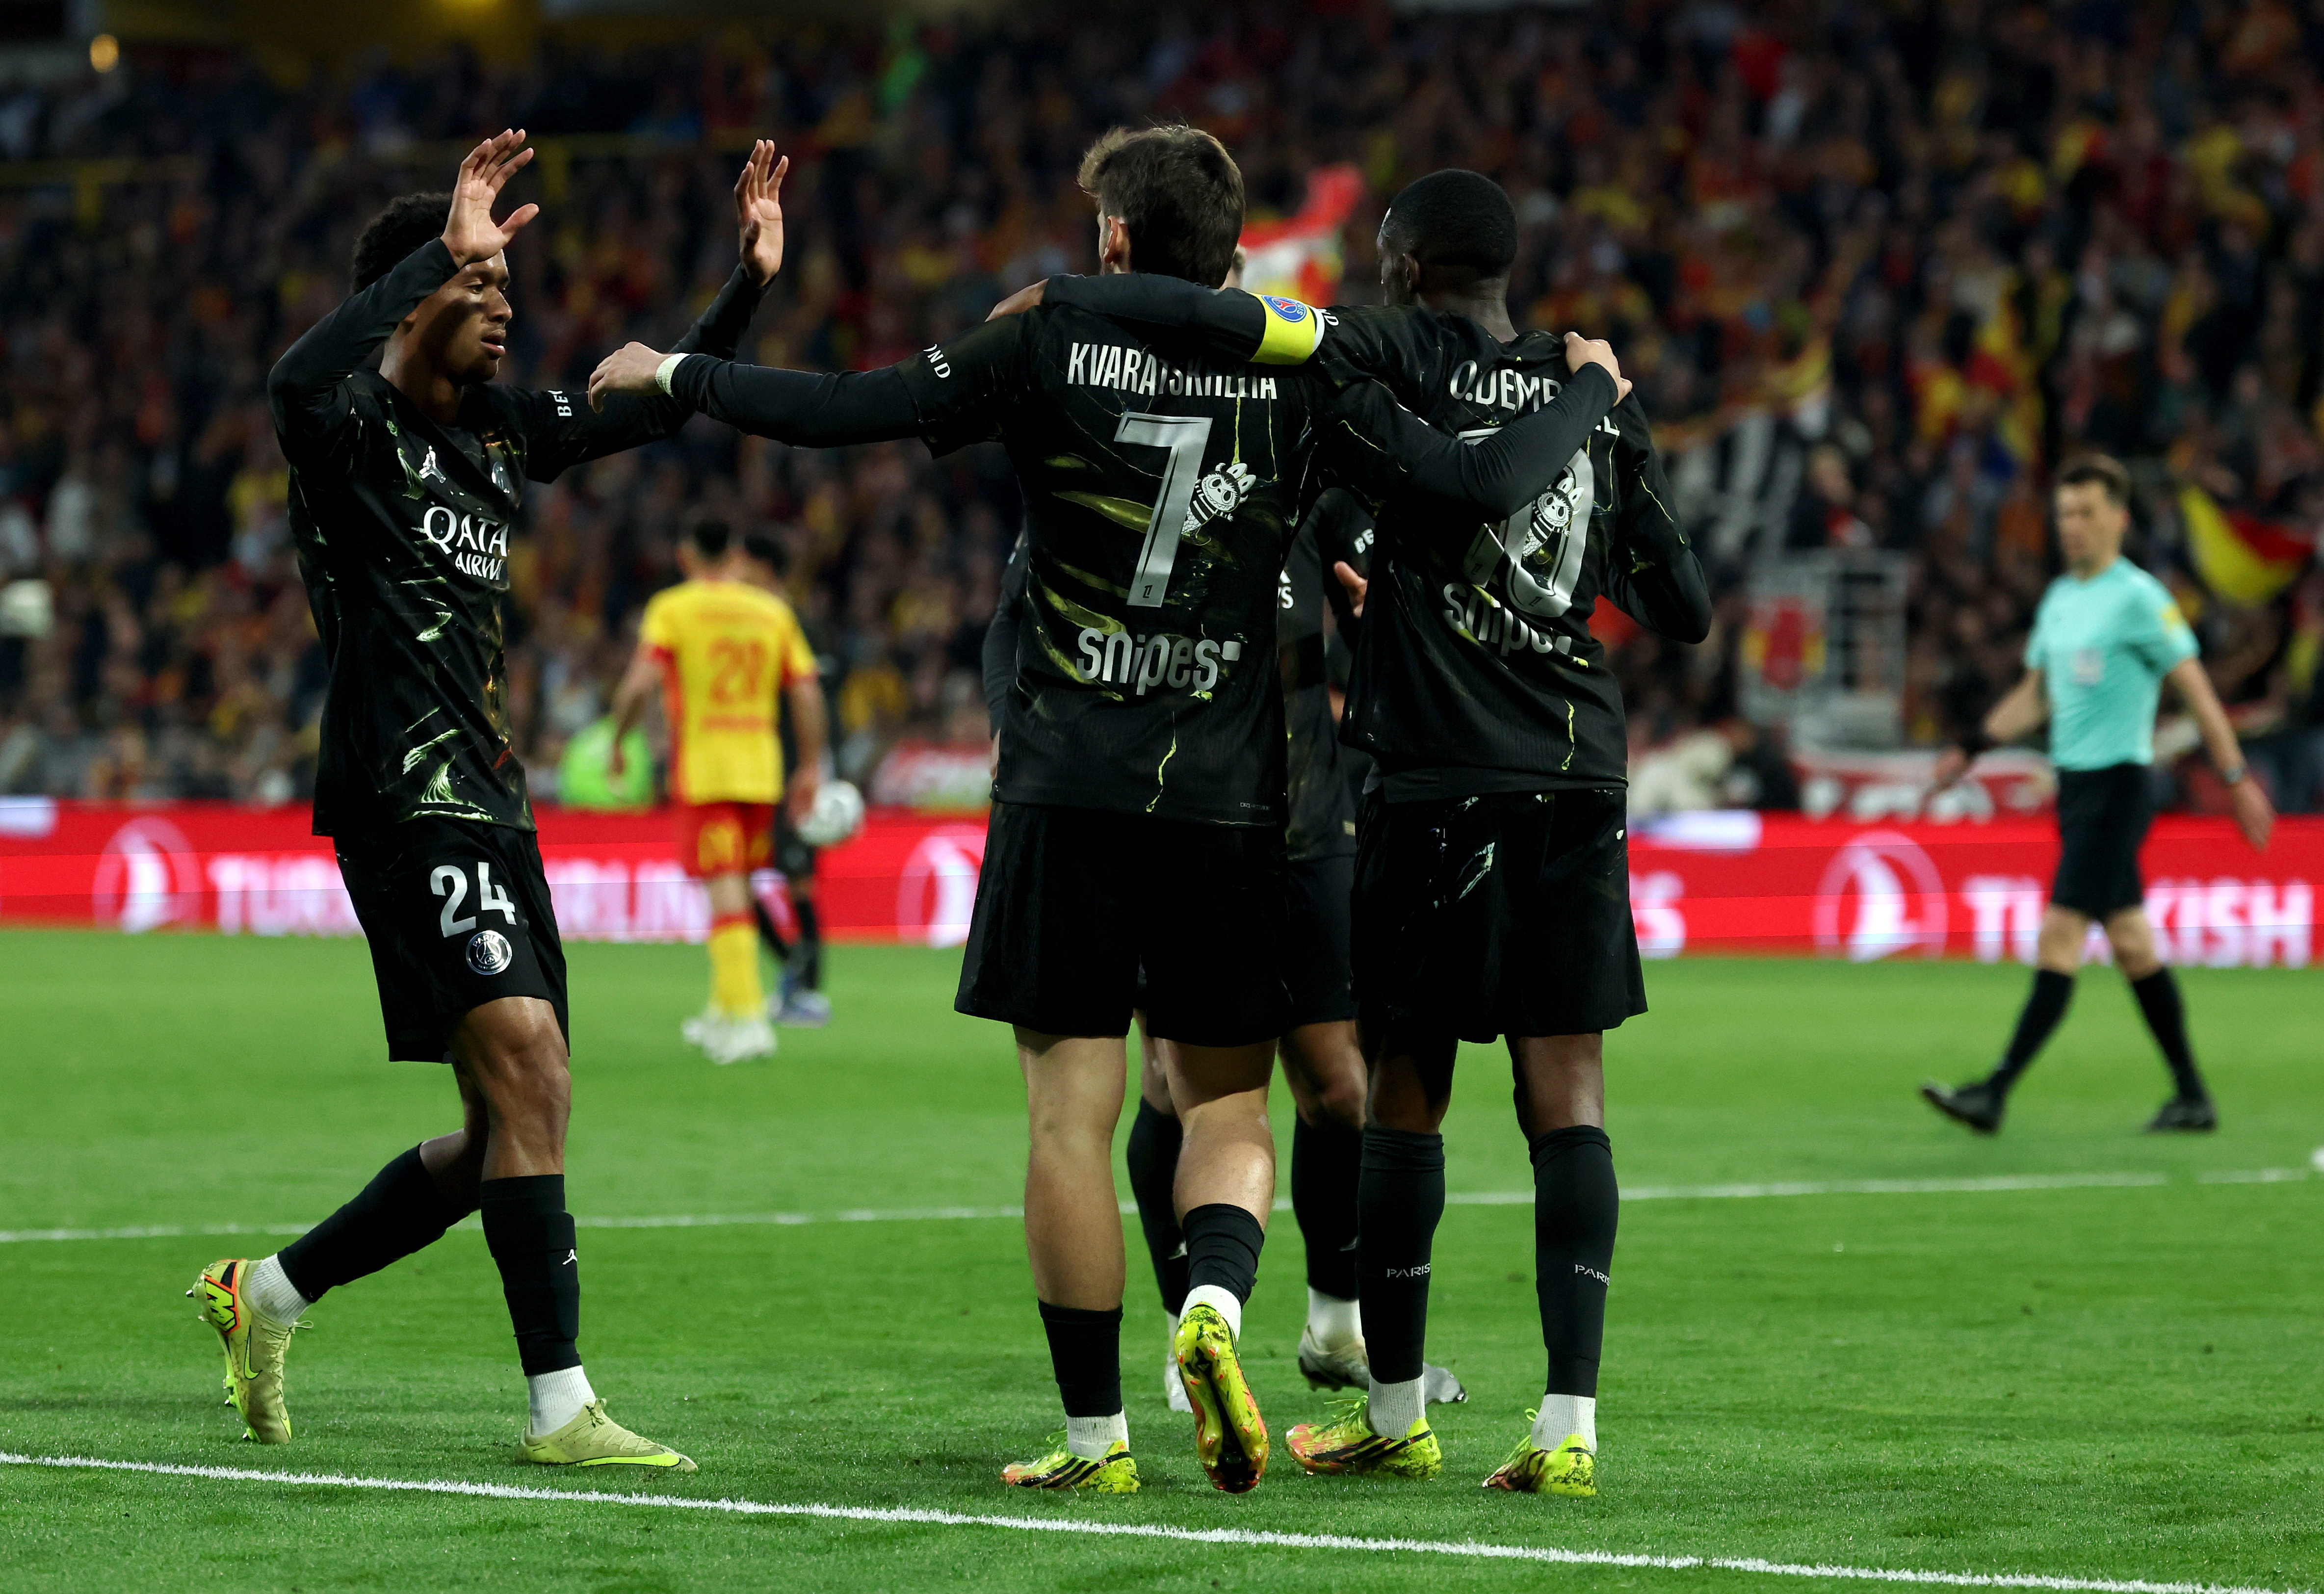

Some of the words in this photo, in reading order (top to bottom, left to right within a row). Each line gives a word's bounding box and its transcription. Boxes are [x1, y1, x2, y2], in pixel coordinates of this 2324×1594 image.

[1114, 411, 1213, 608] 7
[455, 551, 504, 580] AIRW
[1076, 627, 1221, 696] snipes
[430, 861, 517, 938] 24
[1386, 1262, 1431, 1278] PARIS
[1574, 1264, 1611, 1287] PARIS
